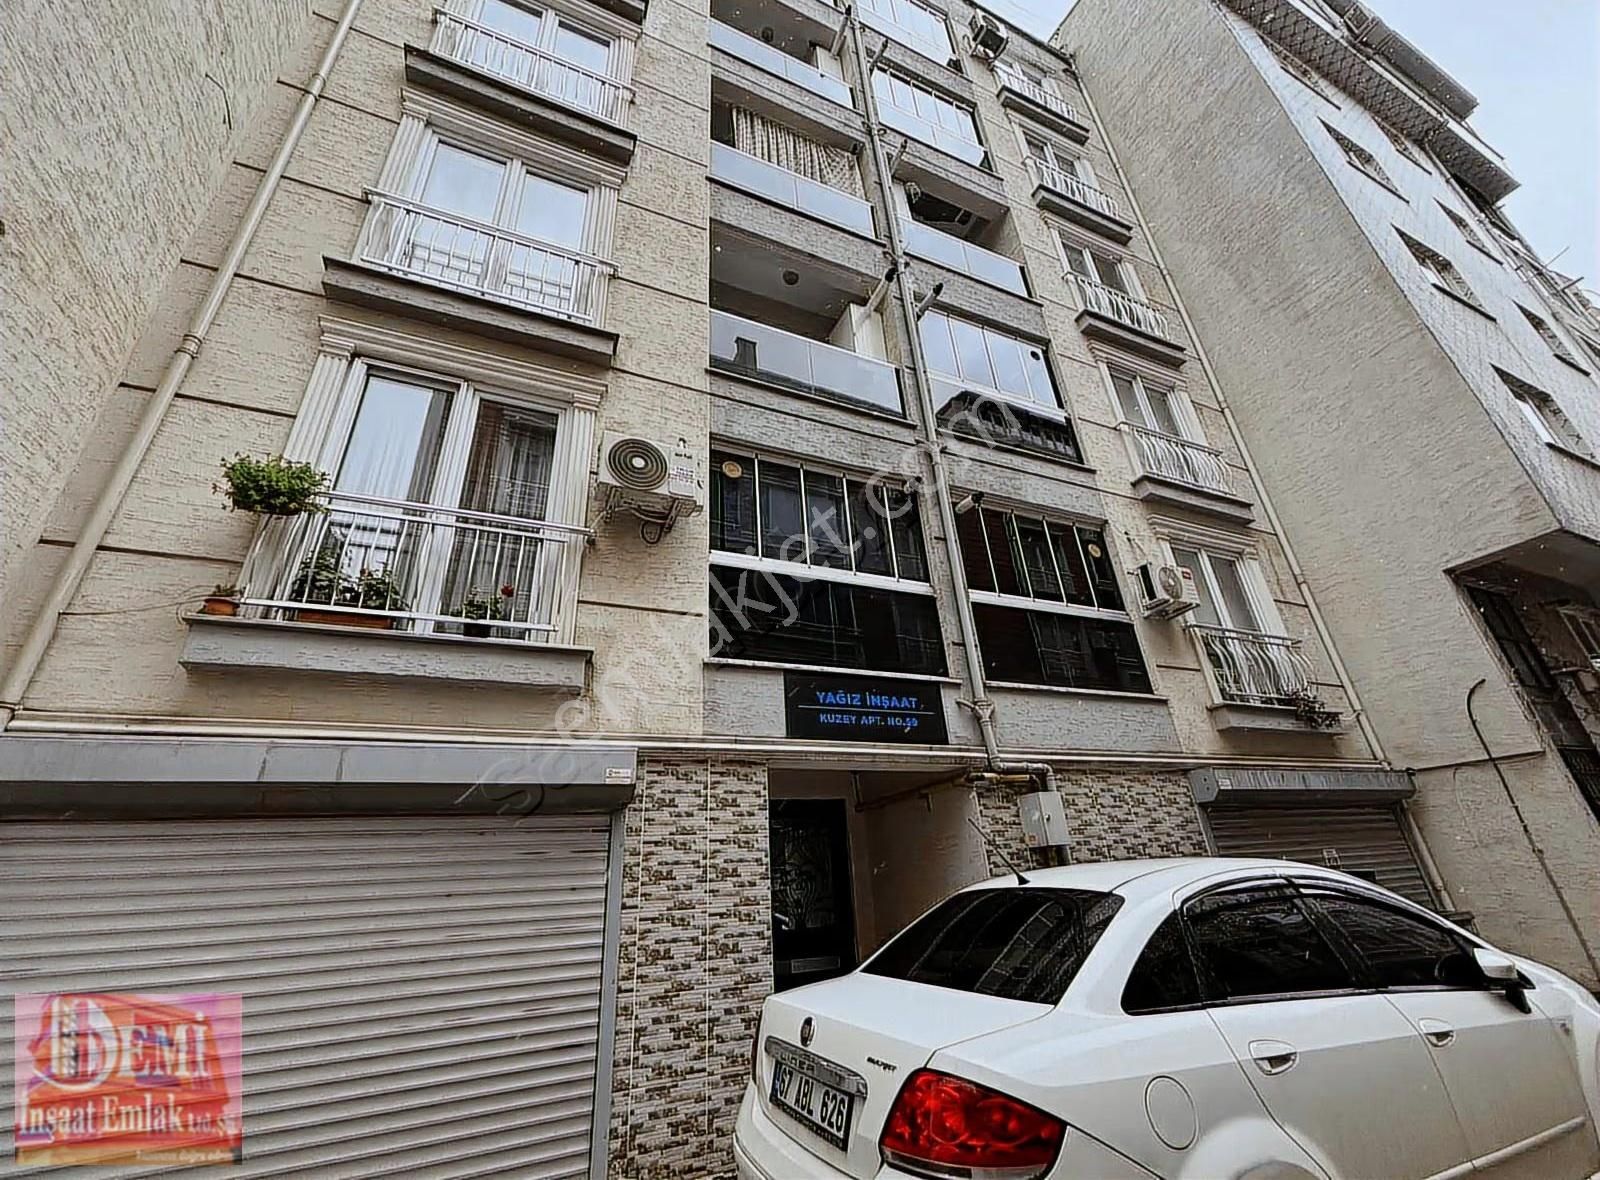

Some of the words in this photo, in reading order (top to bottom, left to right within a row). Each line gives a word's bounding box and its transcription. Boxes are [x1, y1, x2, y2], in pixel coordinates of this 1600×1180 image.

[816, 690, 861, 705] YAĞIZ
[866, 691, 918, 709] İNŞAAT
[820, 713, 857, 724] KUZEY
[860, 715, 885, 725] APT.
[779, 1065, 794, 1100] 67
[793, 1075, 815, 1117] ABL
[820, 1089, 846, 1133] 626
